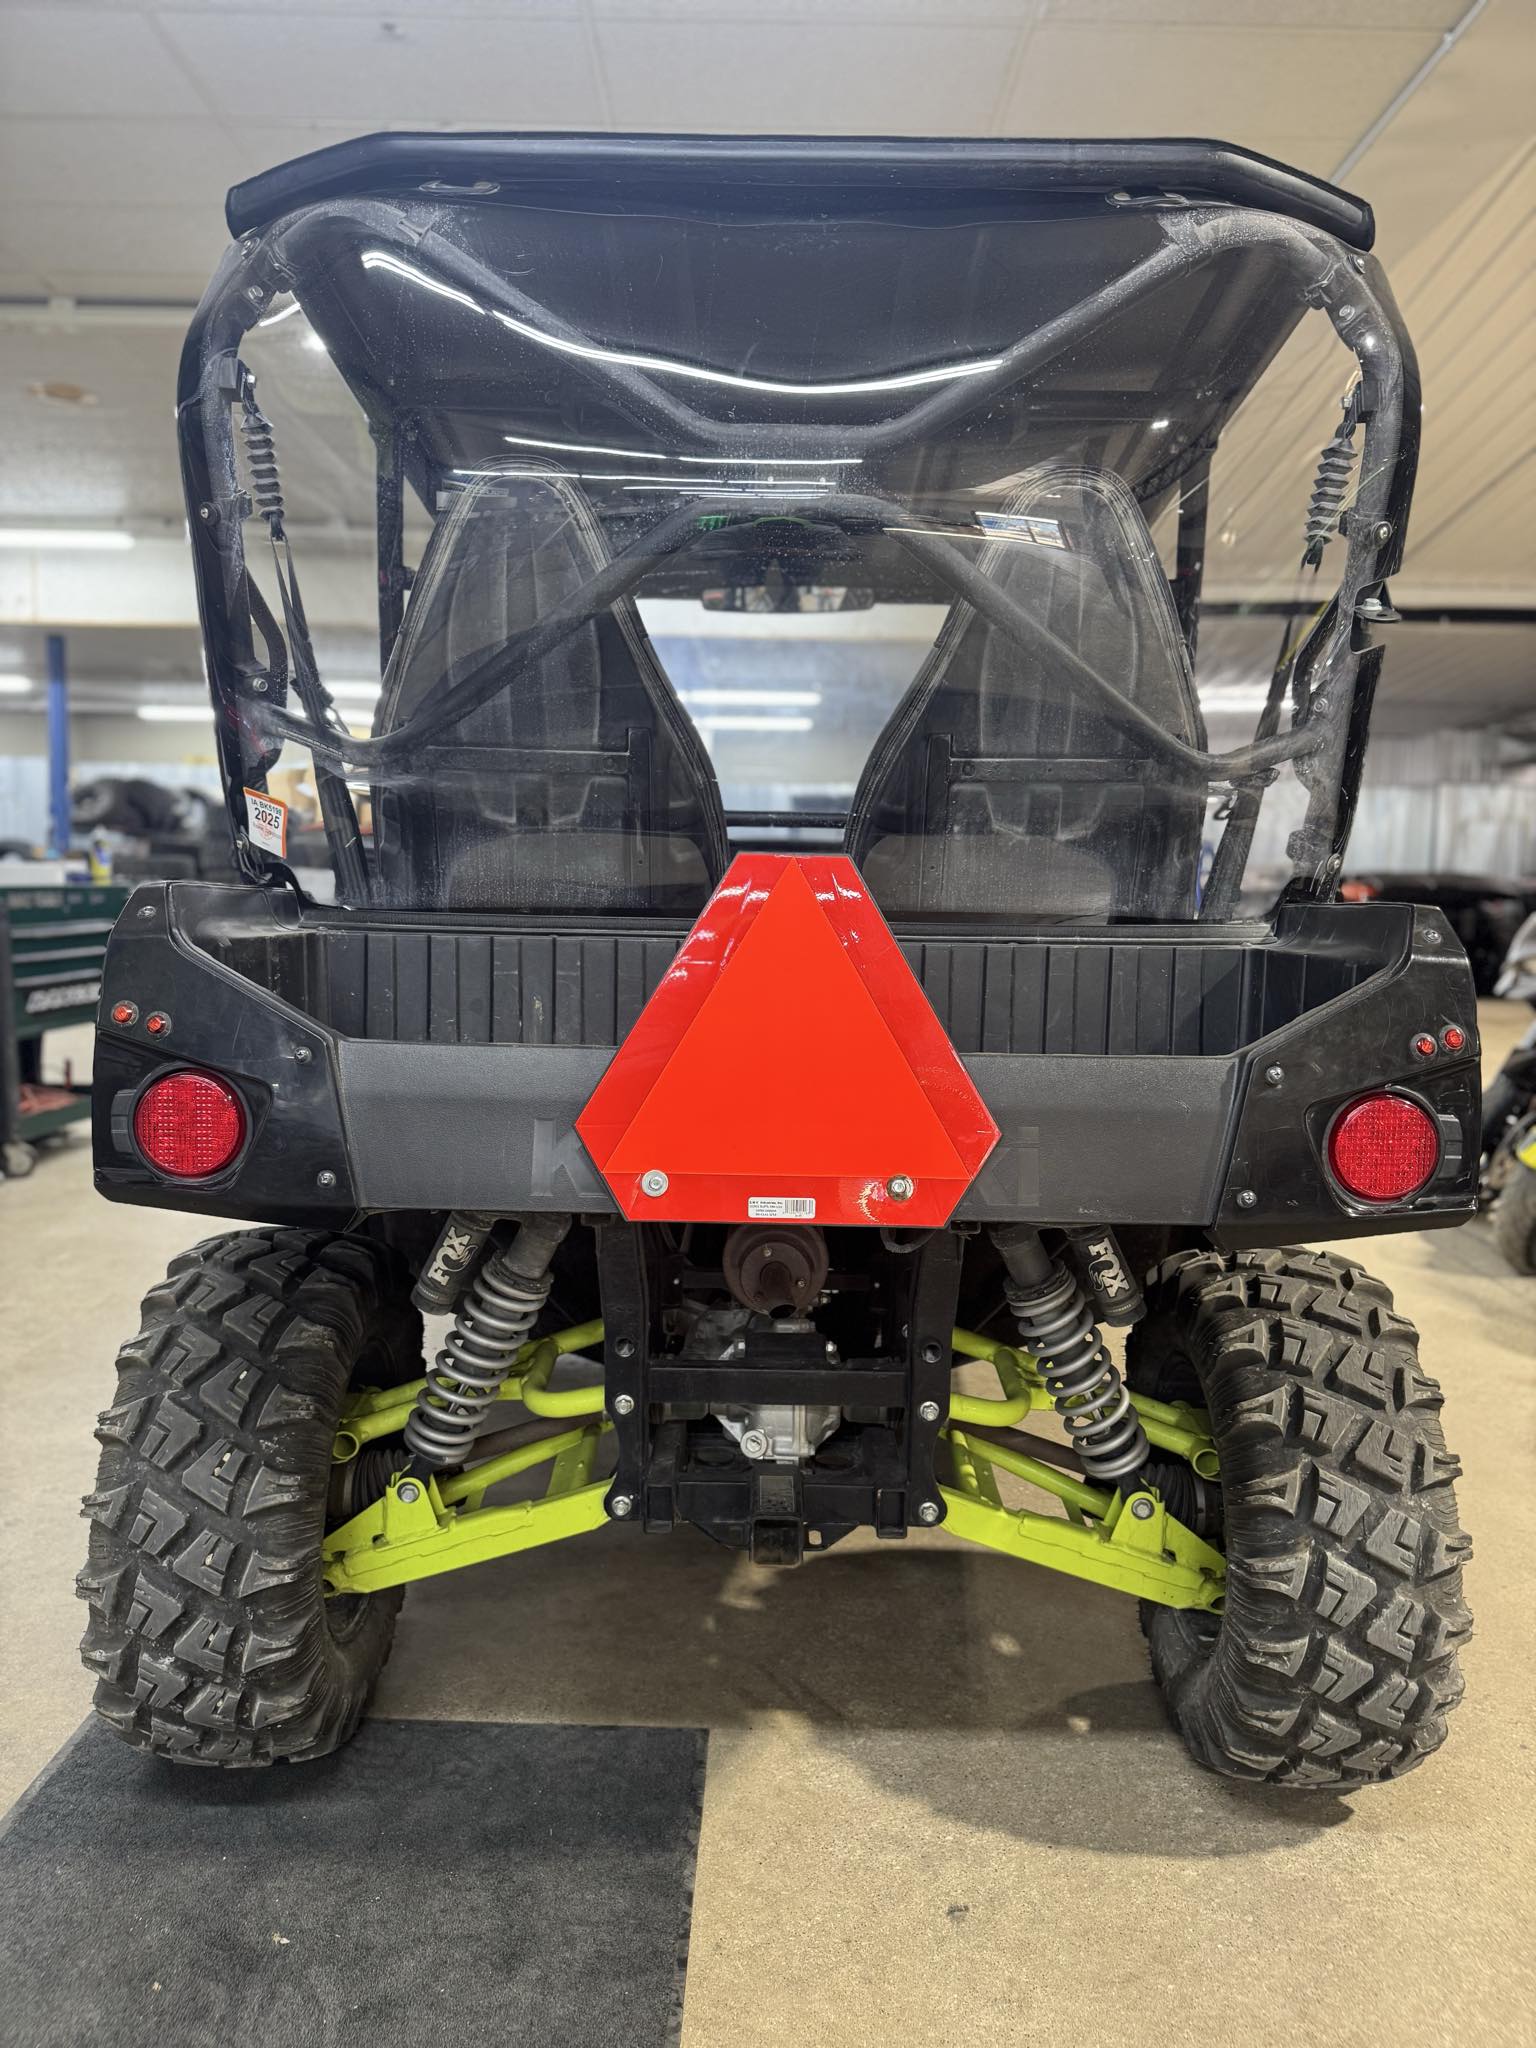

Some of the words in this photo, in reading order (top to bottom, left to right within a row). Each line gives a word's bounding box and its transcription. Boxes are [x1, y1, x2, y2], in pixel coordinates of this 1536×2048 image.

[254, 807, 280, 829] 2025
[427, 1225, 476, 1287] FOX
[1088, 1237, 1130, 1298] FOX
